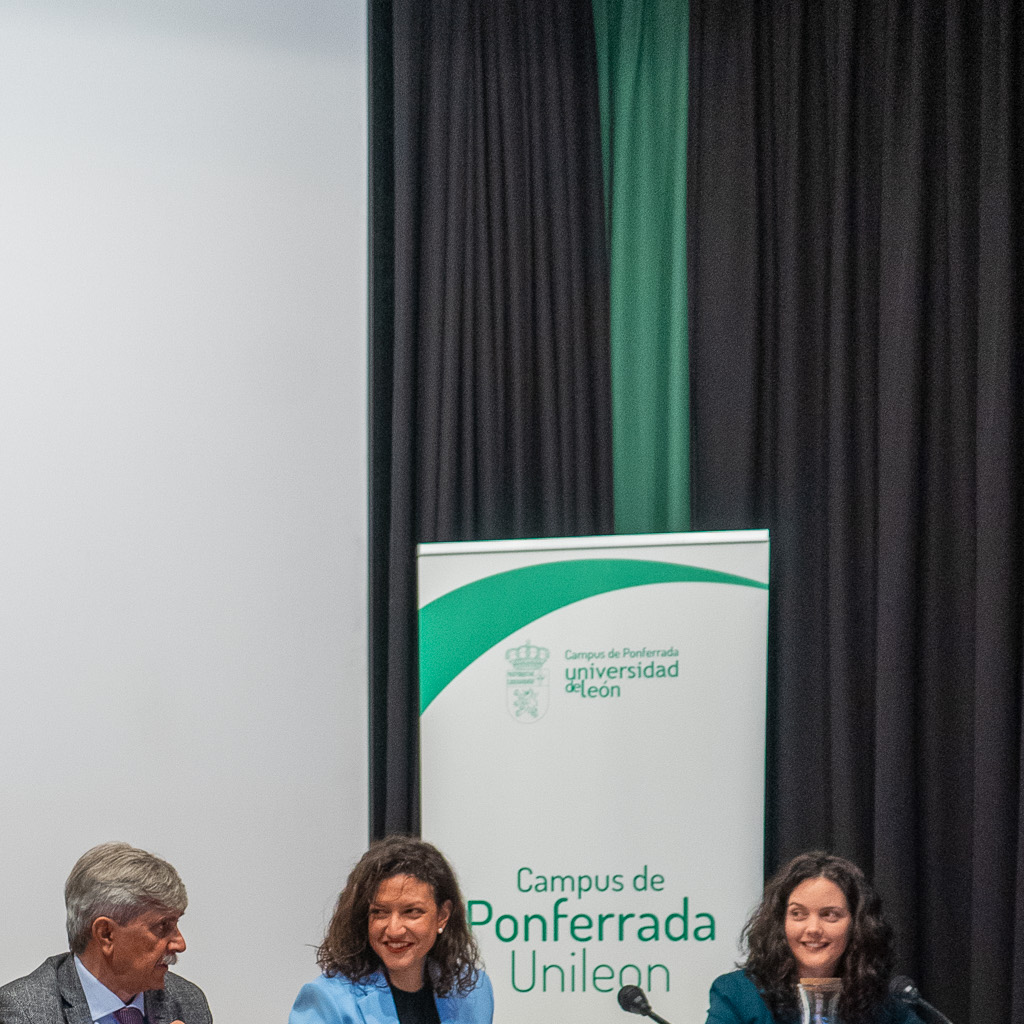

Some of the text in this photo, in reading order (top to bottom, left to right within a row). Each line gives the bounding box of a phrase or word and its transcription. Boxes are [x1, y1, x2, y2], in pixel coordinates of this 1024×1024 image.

[564, 646, 679, 661] Campus de Ponferrada
[565, 660, 679, 682] universidad
[565, 680, 621, 698] de león
[517, 865, 665, 897] Campus de
[467, 896, 716, 943] Ponferrada
[511, 947, 671, 992] Unileon
